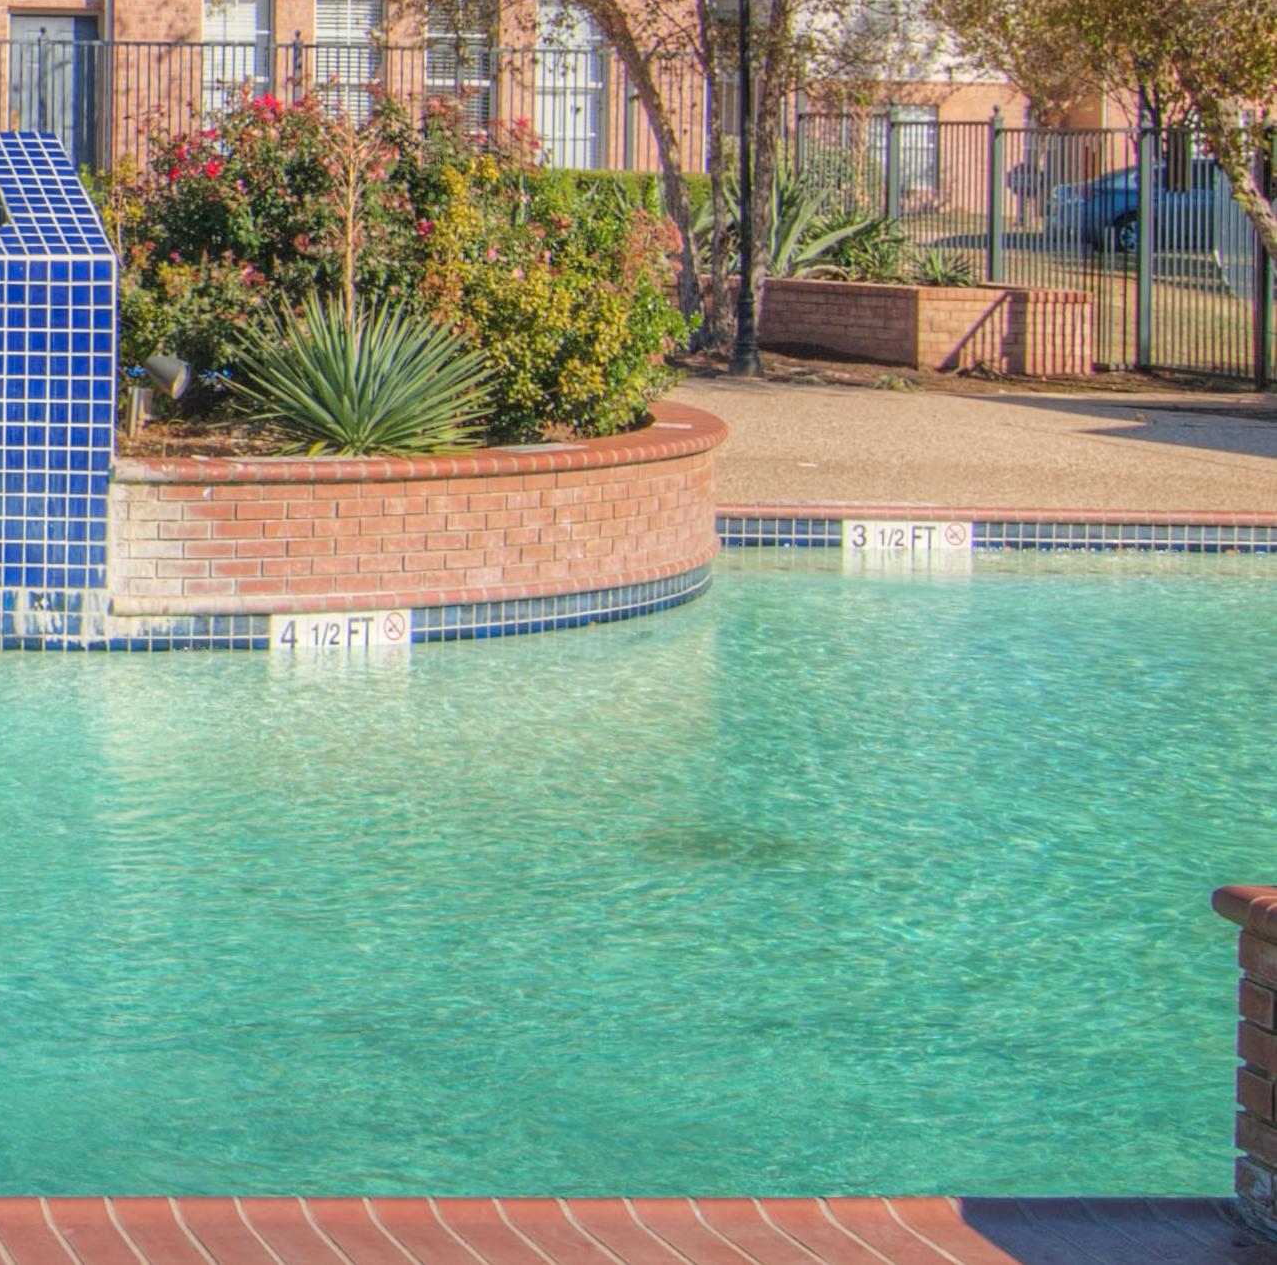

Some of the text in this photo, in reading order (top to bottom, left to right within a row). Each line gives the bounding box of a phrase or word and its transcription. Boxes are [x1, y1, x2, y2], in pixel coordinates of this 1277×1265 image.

[852, 524, 936, 550] 3 1/2 FT
[280, 616, 374, 649] 4 1/2 FT
